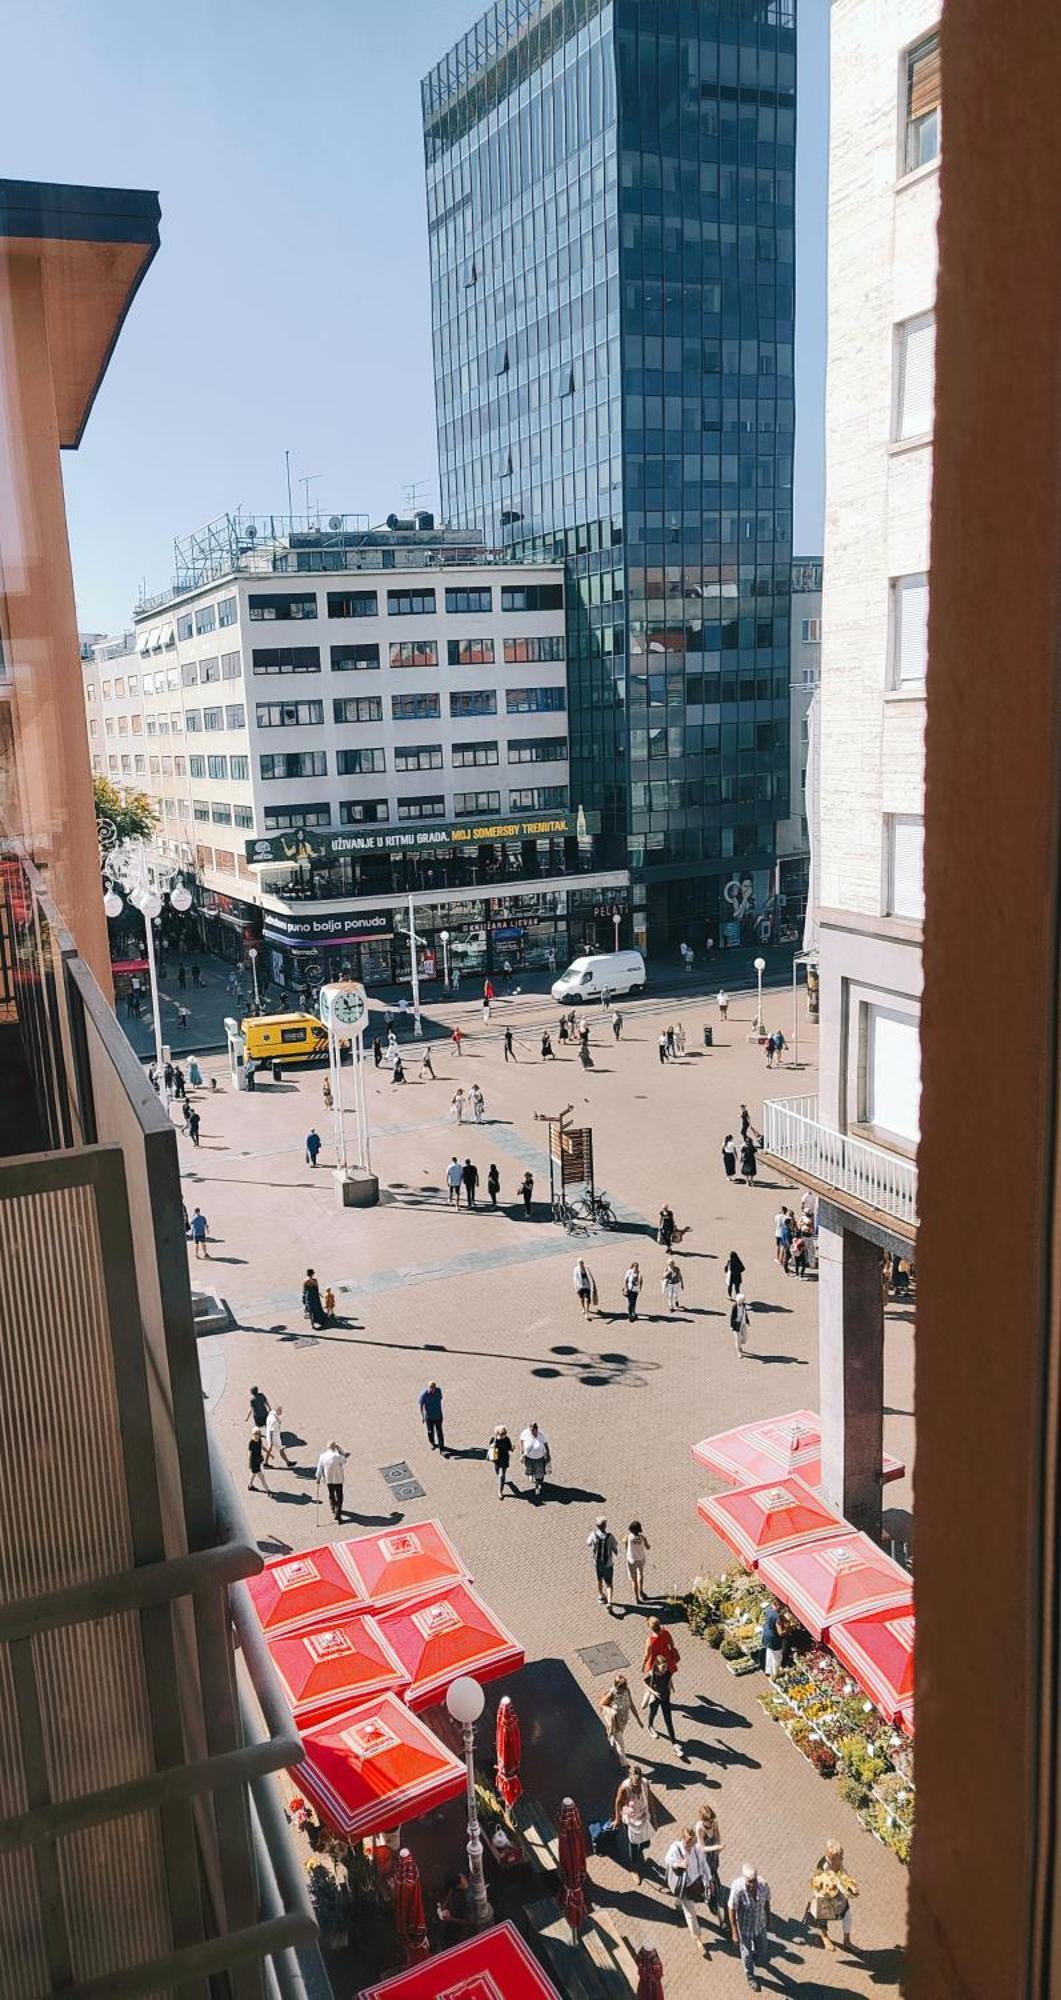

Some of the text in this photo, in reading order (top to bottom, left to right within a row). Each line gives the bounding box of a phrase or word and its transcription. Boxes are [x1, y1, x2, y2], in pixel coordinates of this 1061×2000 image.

[331, 821, 568, 851] UŽIVANJE U RITMU GRADA. MOJ SOMERSBY TRENUTAK.
[288, 922, 310, 933] puno
[313, 920, 342, 932] bolja
[345, 917, 386, 931] ponuda
